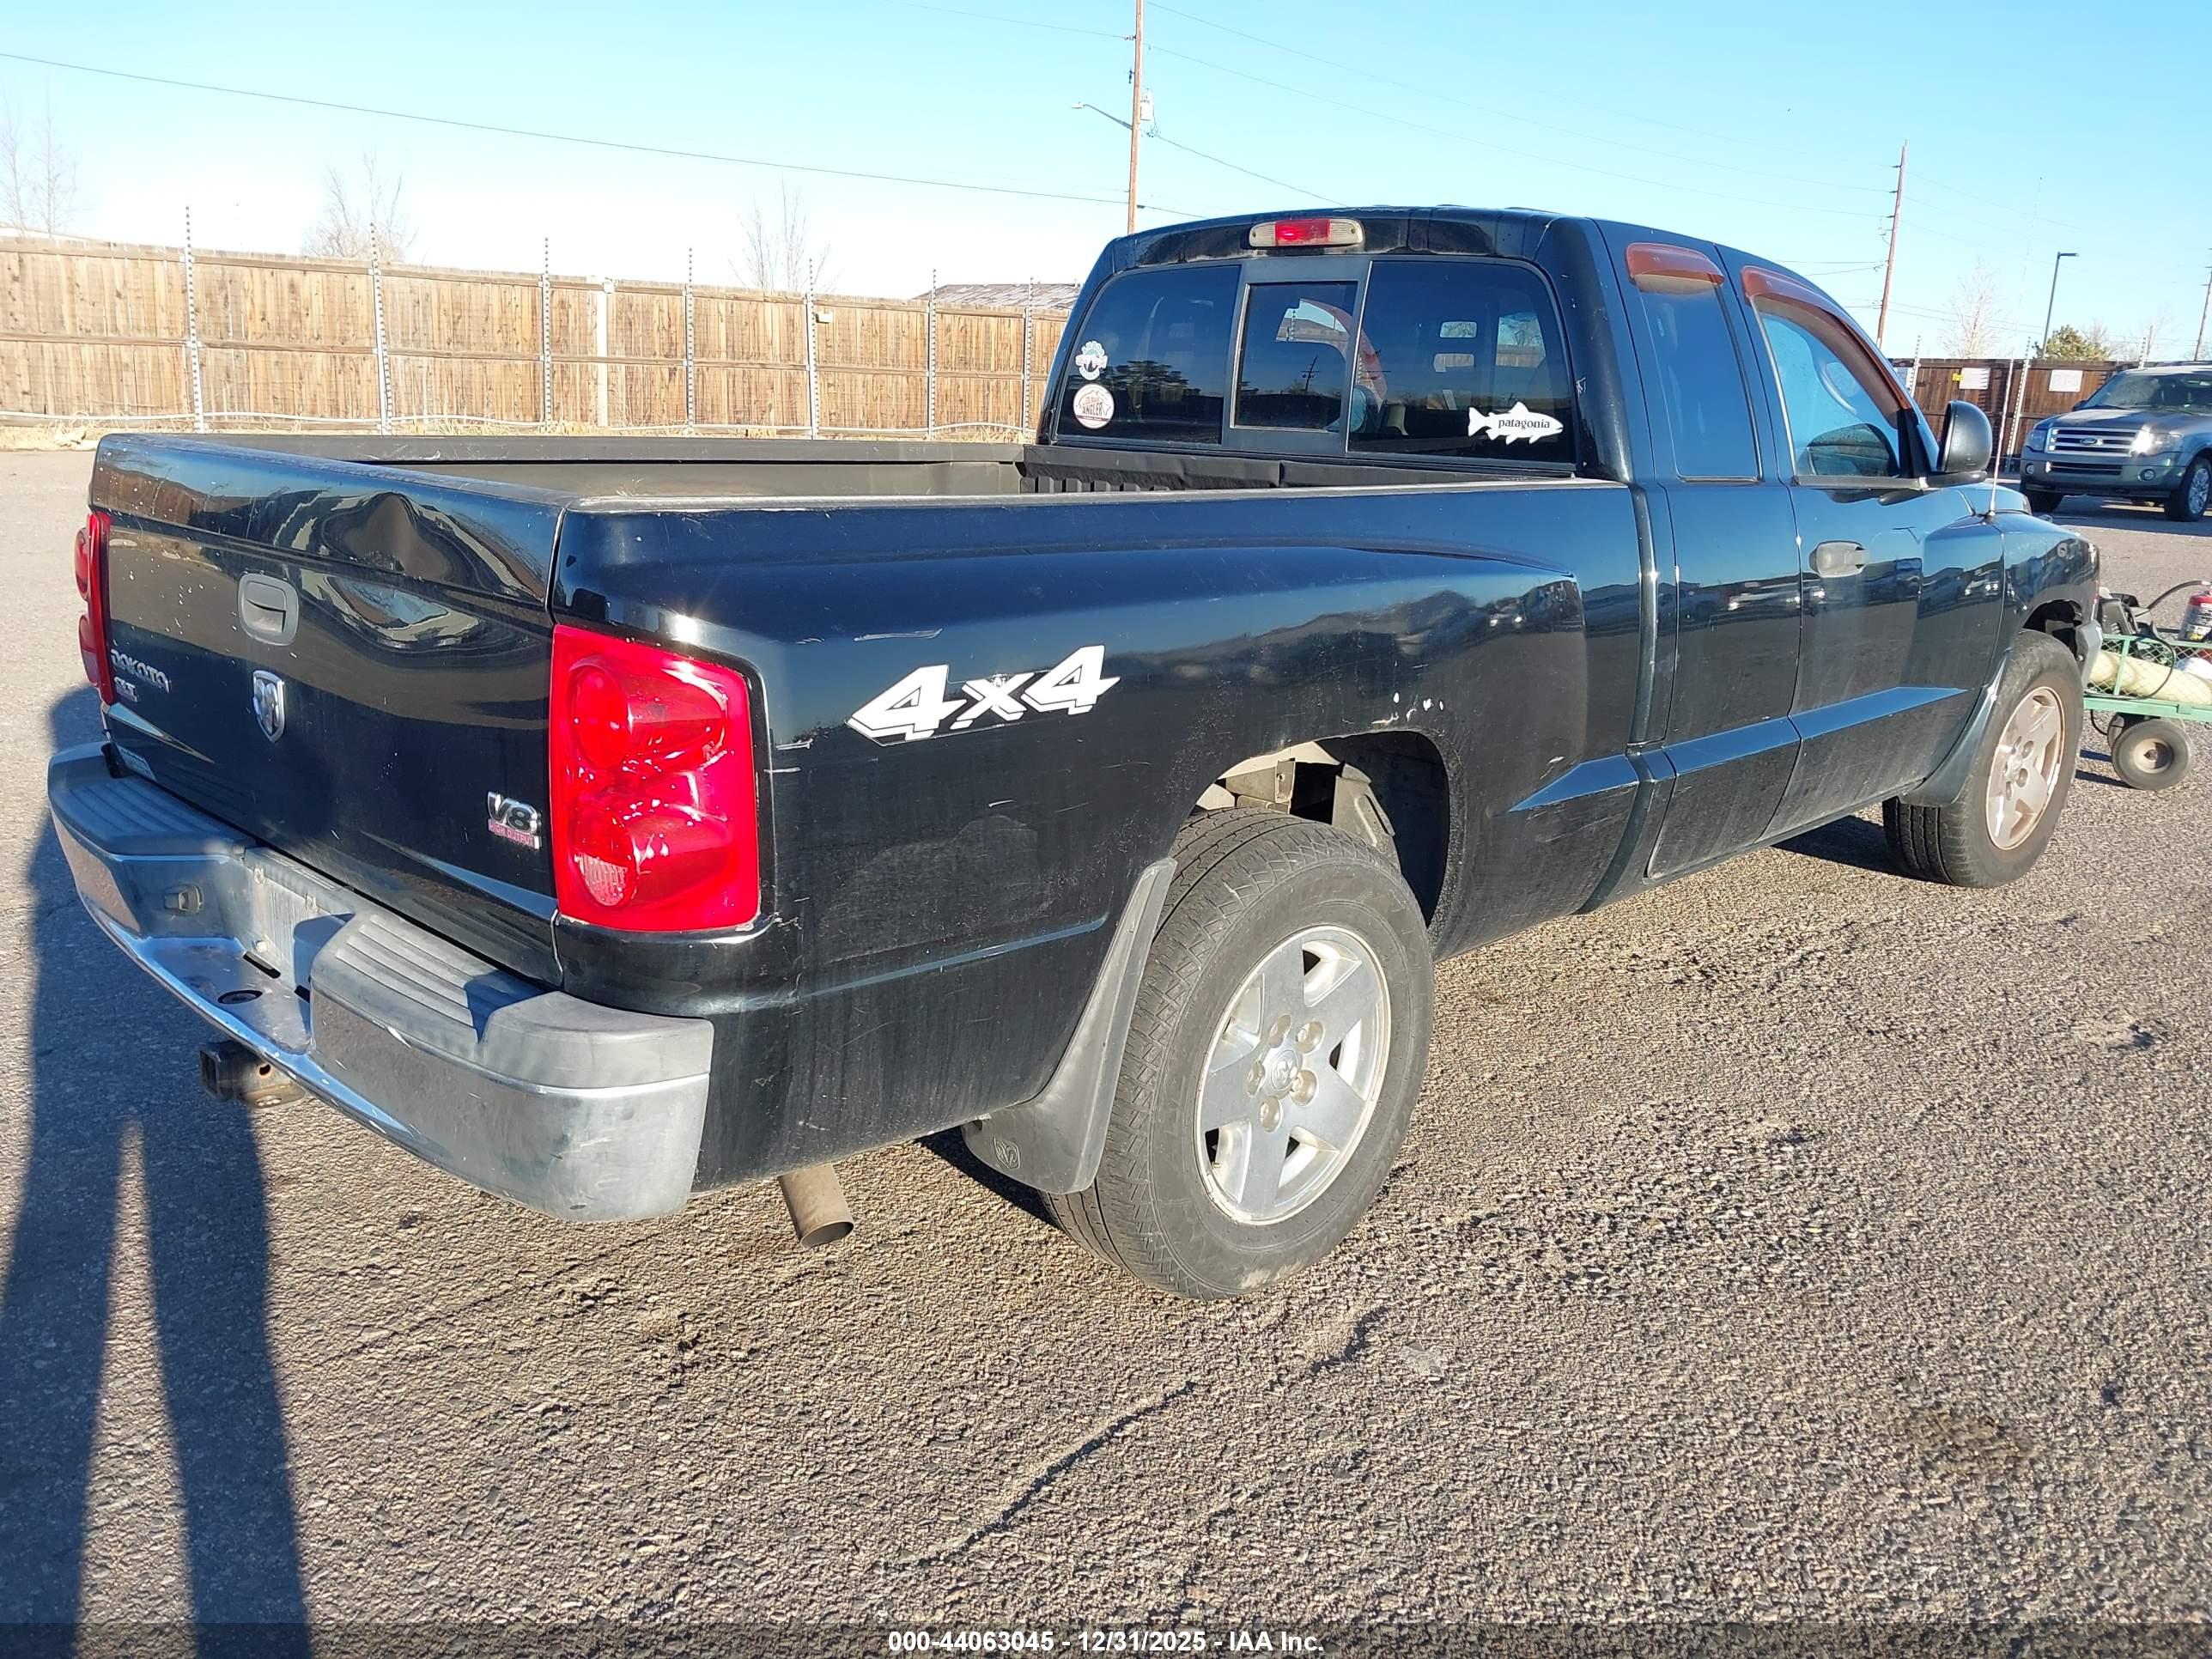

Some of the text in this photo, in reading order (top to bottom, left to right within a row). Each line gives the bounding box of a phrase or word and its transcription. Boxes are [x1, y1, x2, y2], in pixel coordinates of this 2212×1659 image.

[1082, 401, 1103, 416] ANGLER
[1498, 419, 1550, 429] patagonia
[488, 792, 539, 835] V8
